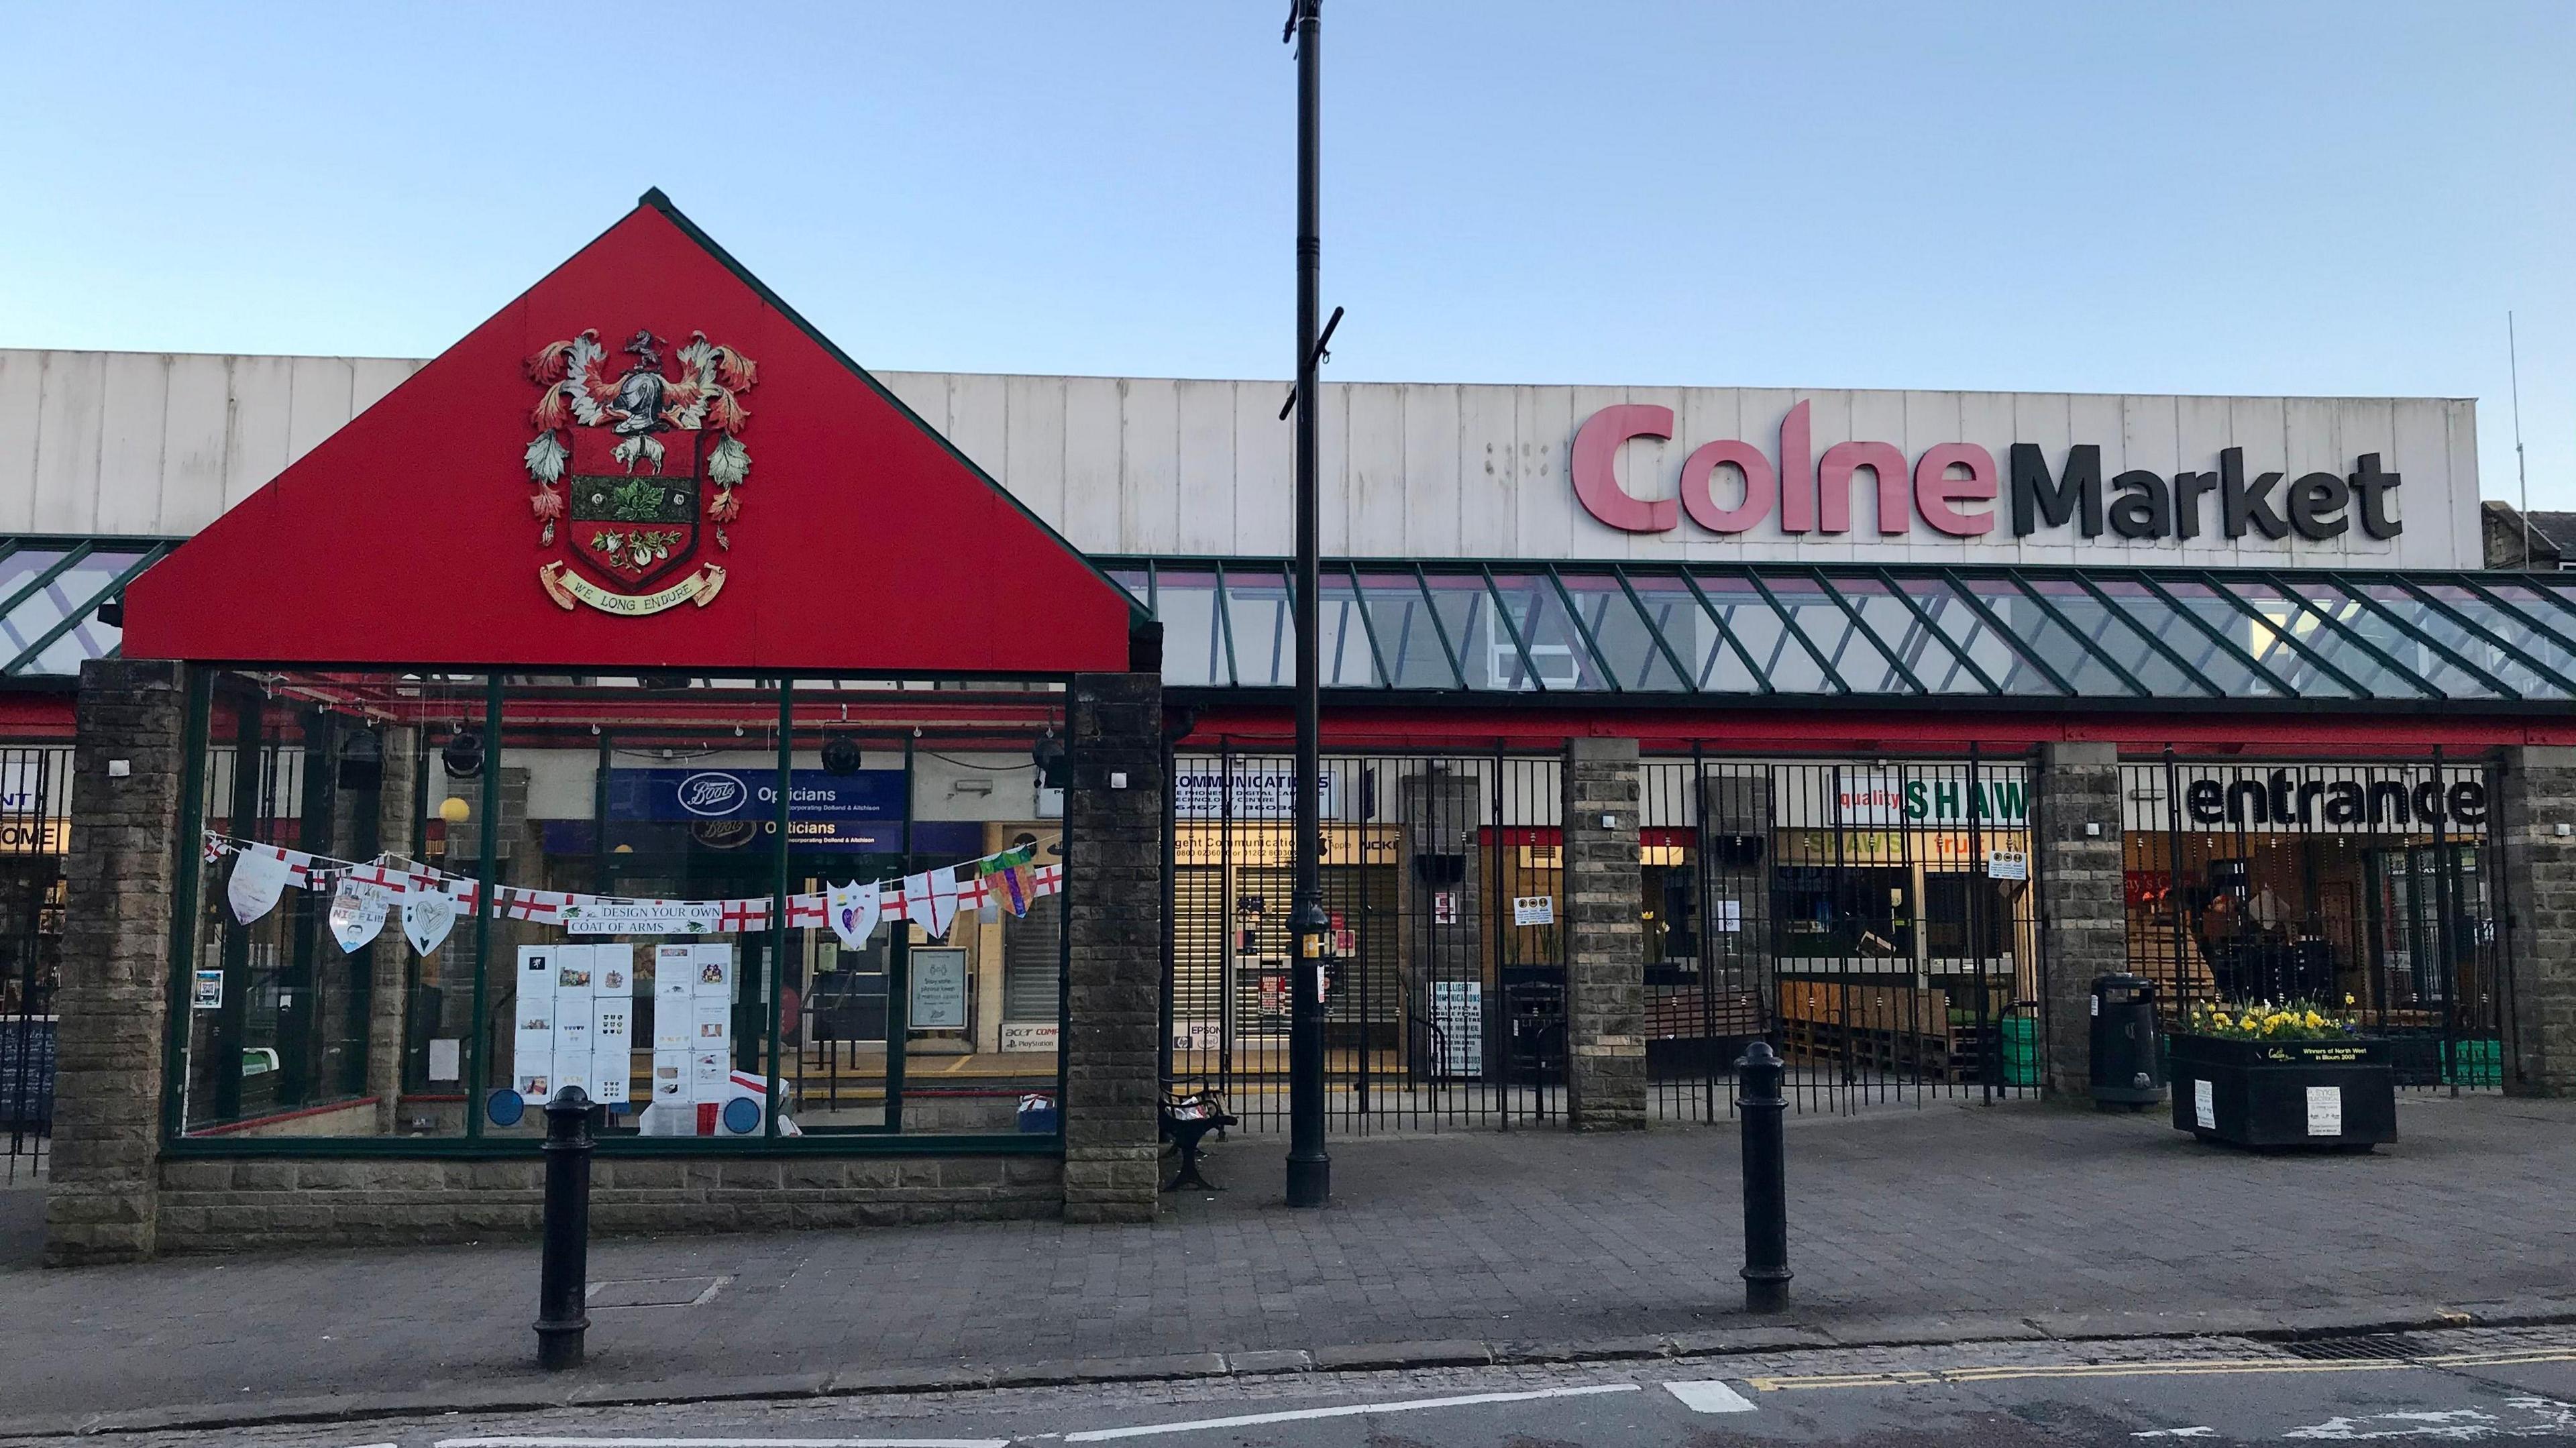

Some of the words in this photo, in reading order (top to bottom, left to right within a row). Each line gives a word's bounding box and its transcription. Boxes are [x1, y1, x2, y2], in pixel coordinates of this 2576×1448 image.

[1572, 398, 1996, 535] Colne
[2010, 443, 2403, 539] Market
[574, 581, 593, 600] WE
[600, 595, 635, 610] LONG
[644, 583, 692, 610] ENDURE
[687, 781, 736, 805] Boots
[758, 786, 837, 804] Opicians
[1840, 789, 1900, 810] quality
[2188, 769, 2485, 825] entrance
[765, 822, 836, 834] Oticians
[603, 907, 648, 917] DESIGN
[651, 907, 686, 917] YOUR
[691, 907, 720, 917] OWN
[572, 922, 603, 932] COAT
[608, 922, 624, 932] OF
[629, 922, 664, 932] ARMS
[1191, 1026, 1221, 1034] EPSON
[1018, 1040, 1053, 1048] PlayStation
